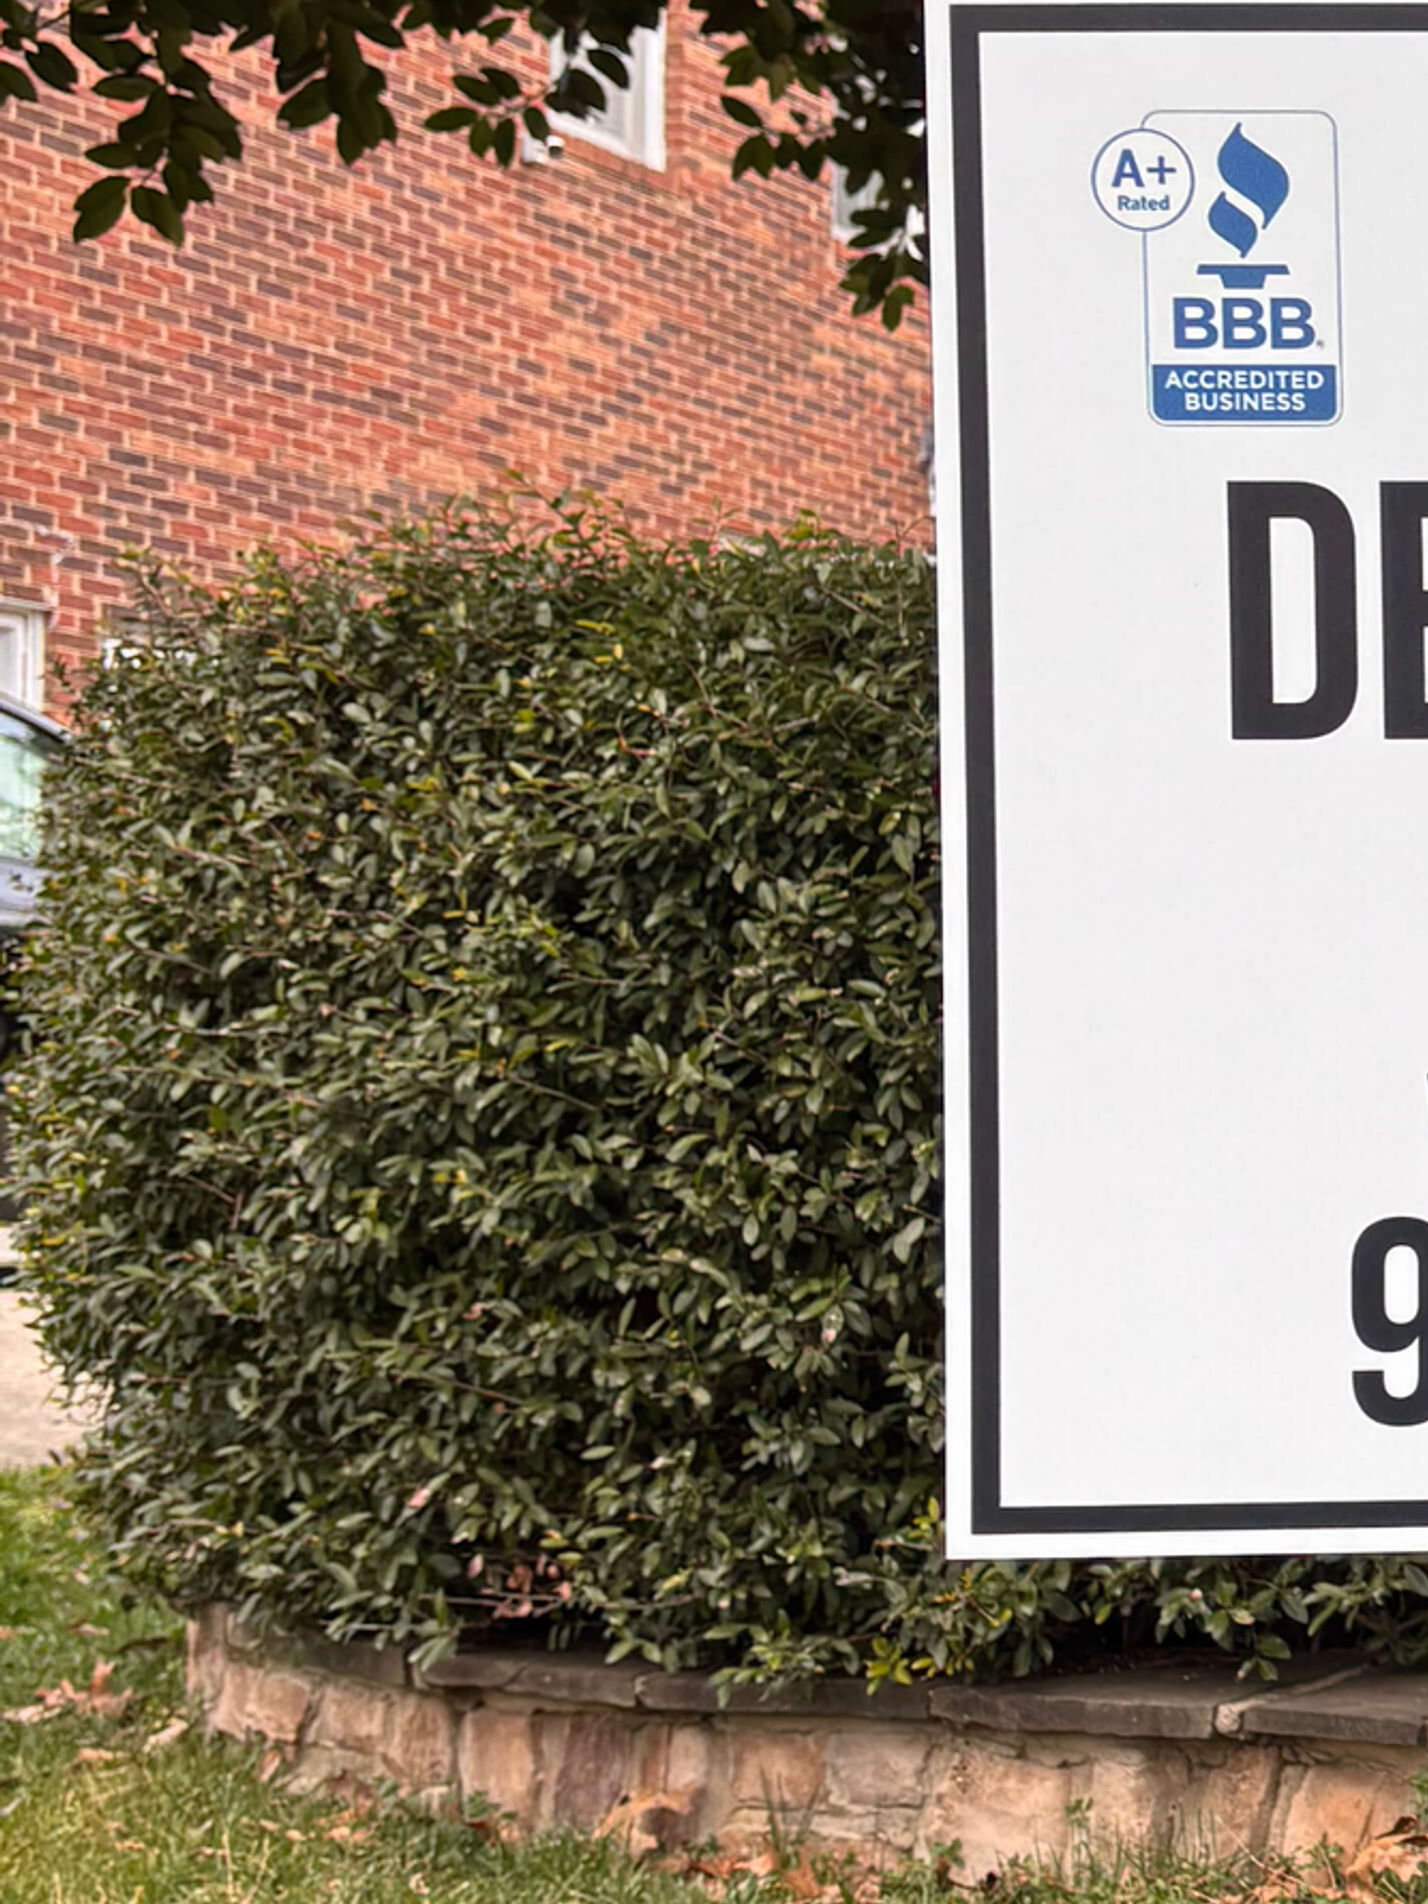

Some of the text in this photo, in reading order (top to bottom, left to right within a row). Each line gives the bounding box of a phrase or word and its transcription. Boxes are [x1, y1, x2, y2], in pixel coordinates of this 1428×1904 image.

[1112, 149, 1176, 187] A+
[1117, 195, 1171, 211] Rated
[1164, 370, 1324, 390] ACCREDITED
[1184, 392, 1306, 411] BUSINESS
